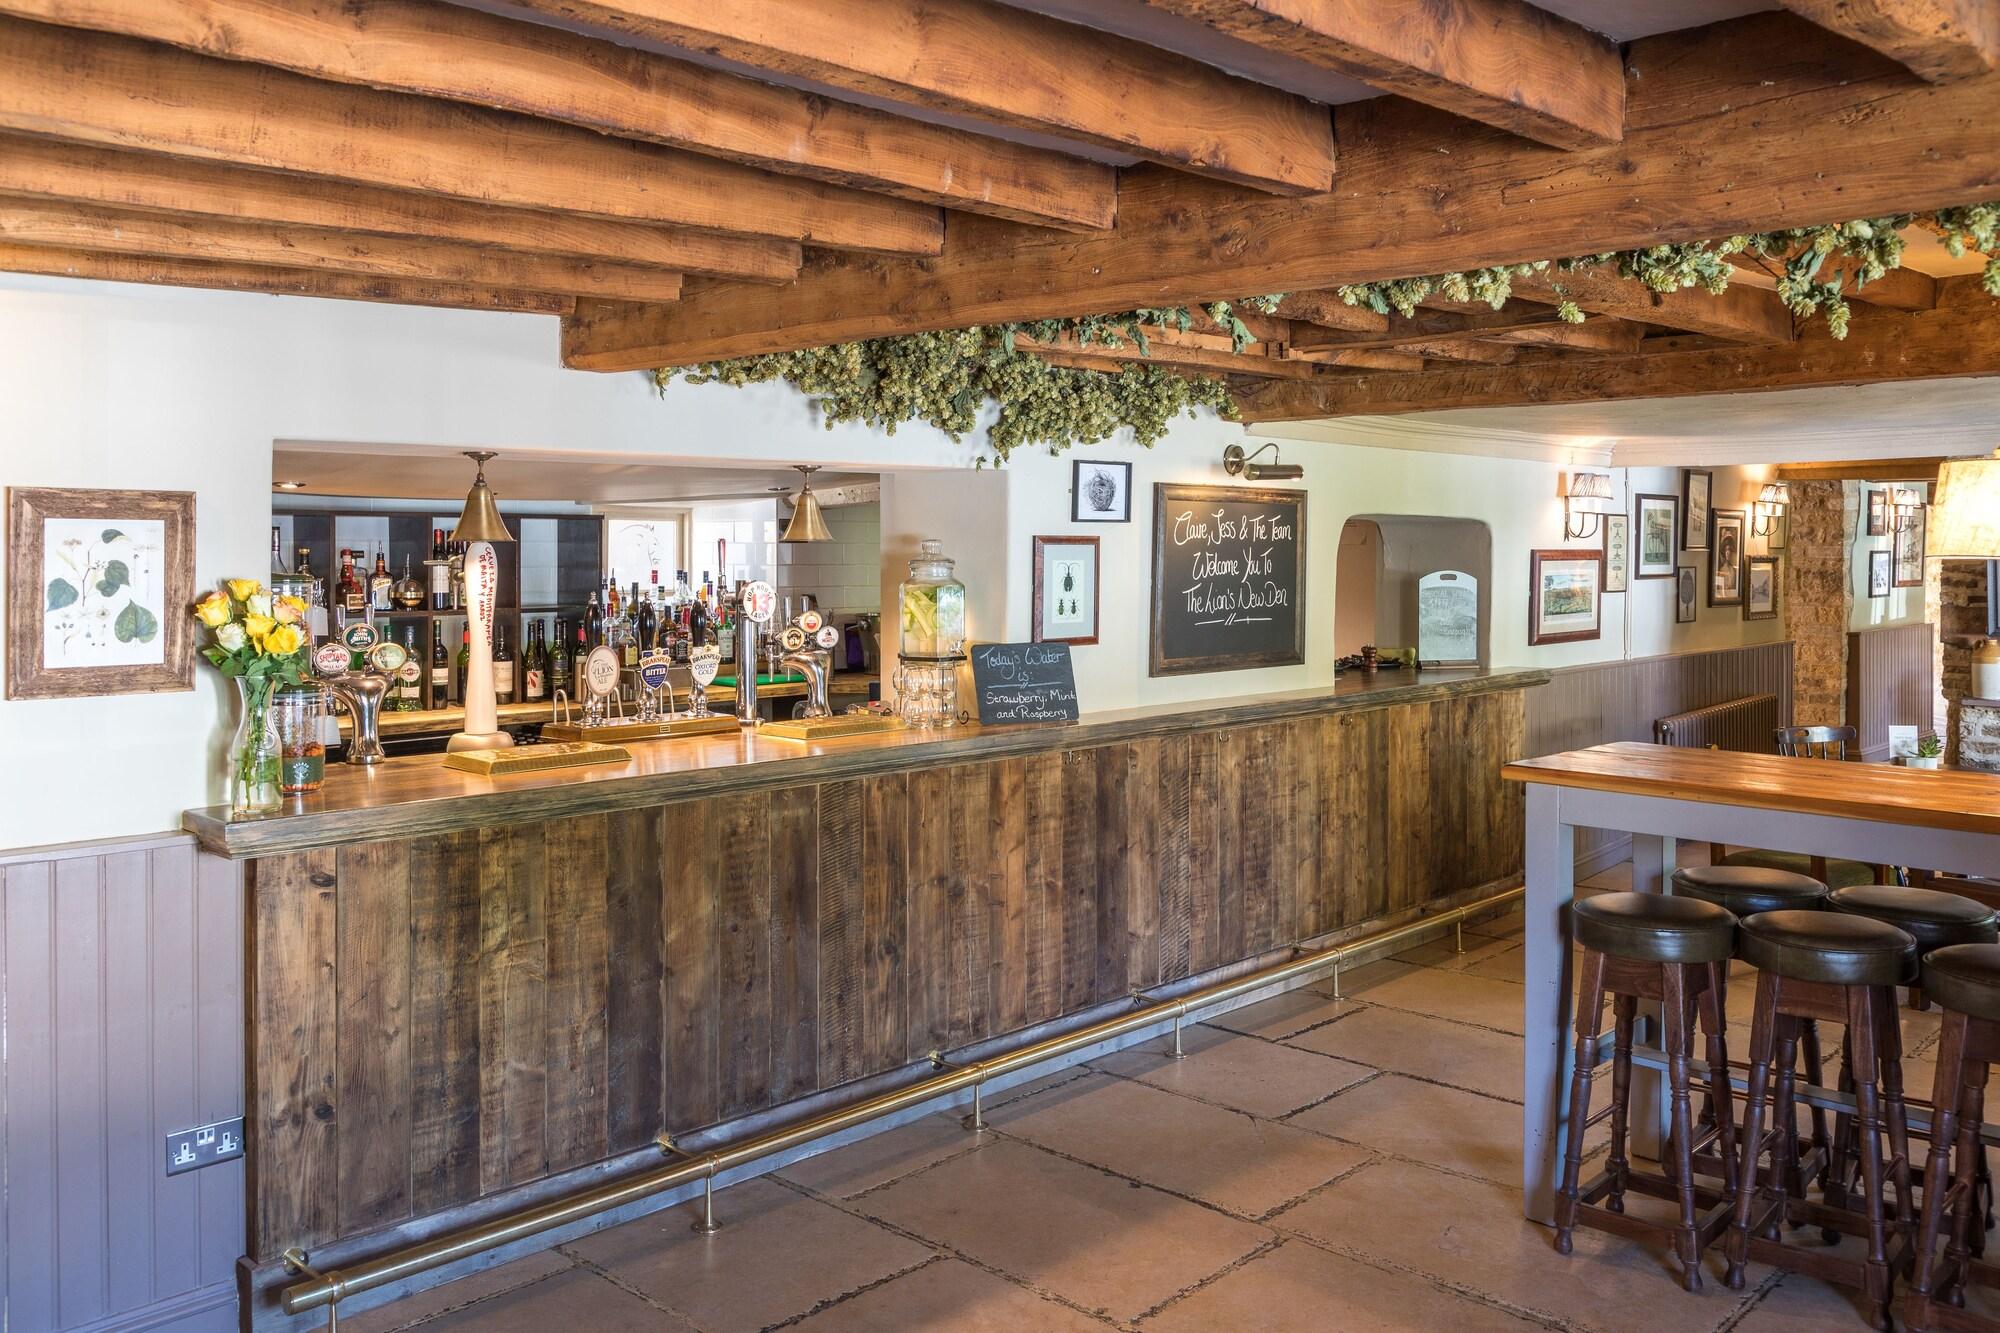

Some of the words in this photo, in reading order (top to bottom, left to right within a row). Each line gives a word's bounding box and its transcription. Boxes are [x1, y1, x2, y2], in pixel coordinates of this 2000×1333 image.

[1174, 511, 1211, 546] Claire,
[1211, 509, 1236, 545] Jess
[1239, 515, 1248, 539] &
[1249, 515, 1268, 542] The
[1268, 515, 1292, 541] Team
[1192, 552, 1240, 581] Welcome
[1241, 547, 1260, 583] You
[1260, 547, 1273, 576] To
[1182, 583, 1203, 613] The
[1204, 581, 1236, 614] Lion's
[1238, 581, 1265, 611] New
[1264, 581, 1287, 608] Den
[979, 647, 1020, 680] Today's
[1025, 646, 1065, 665] Water
[1049, 689, 1077, 701] Mint
[997, 709, 1016, 719] and
[1016, 704, 1068, 720] Raspberry
